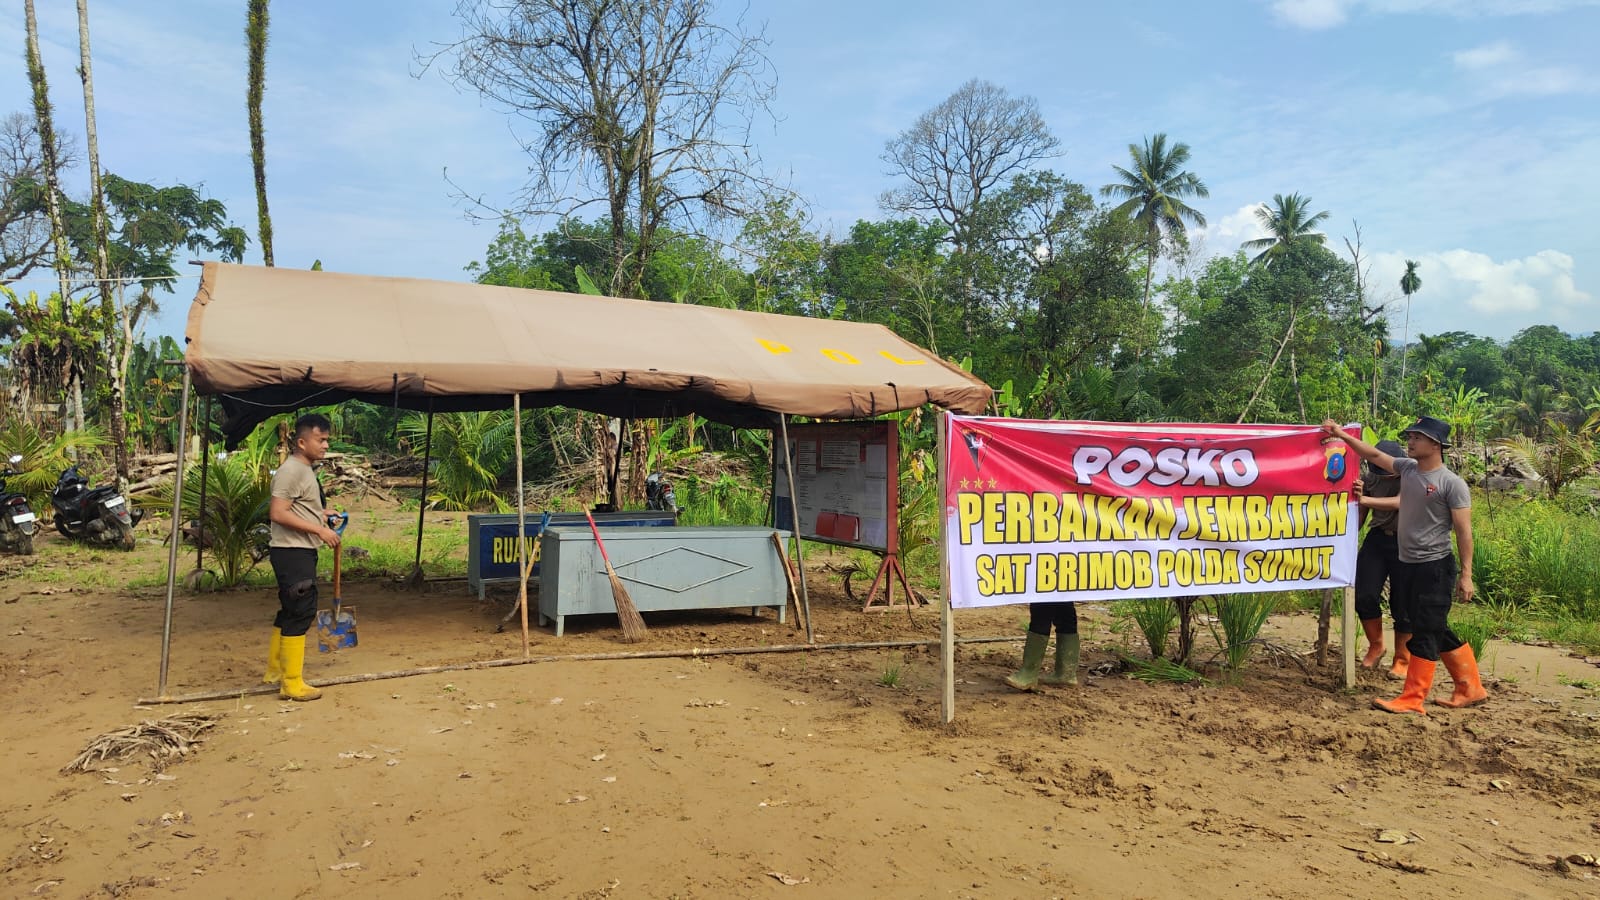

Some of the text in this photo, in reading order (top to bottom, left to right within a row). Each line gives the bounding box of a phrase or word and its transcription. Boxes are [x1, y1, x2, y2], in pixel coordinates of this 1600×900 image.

[1072, 445, 1260, 488] POSKO
[957, 491, 1349, 545] PERBAIKAN JEMBATAN
[975, 546, 1334, 597] SAT BRIMOB POLDA SUMUT
